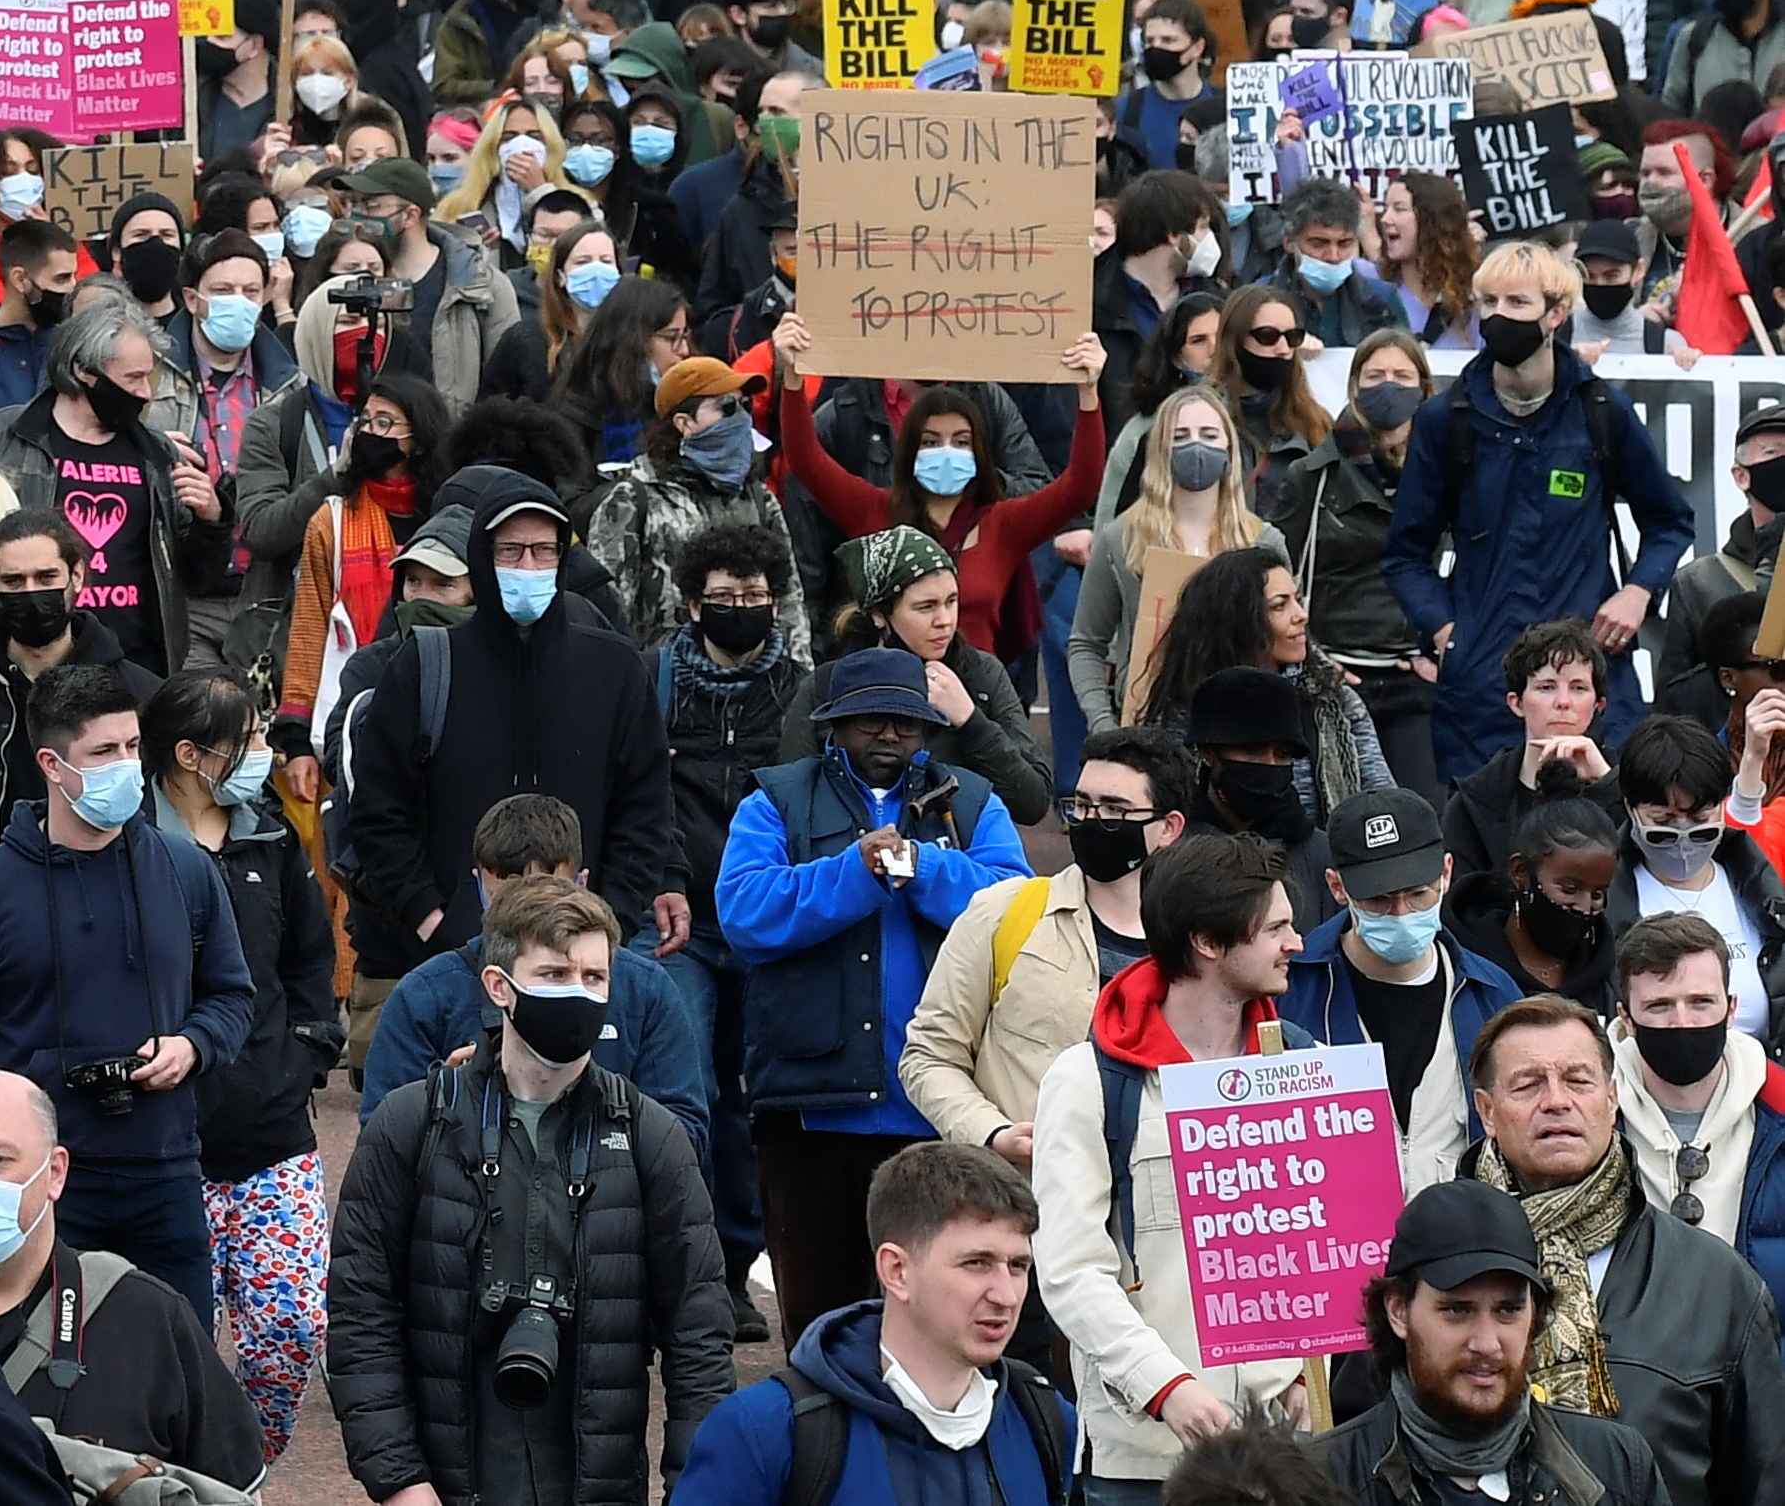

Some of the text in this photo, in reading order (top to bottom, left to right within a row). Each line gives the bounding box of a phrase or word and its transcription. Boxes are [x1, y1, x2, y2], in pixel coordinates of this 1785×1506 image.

[72, 0, 171, 27] Defend the
[42, 39, 64, 57] to
[73, 25, 145, 51] right to
[838, 18, 907, 48] THE
[1025, 26, 1106, 56] BILL
[74, 47, 143, 75] protest
[841, 49, 920, 79] BILL
[75, 68, 177, 94] Black Lives
[1370, 61, 1470, 103] REVOLUTION
[76, 96, 140, 117] Matter
[814, 111, 1091, 171] RIGHTS IN THE
[1473, 120, 1550, 163] KILL
[50, 146, 180, 190] KILL
[1482, 157, 1548, 196] THE
[914, 173, 991, 211] UK:
[1486, 187, 1567, 233] BILL
[804, 222, 1047, 273] THE RIGHT
[851, 286, 1068, 342] TO PROTEST
[91, 550, 109, 574] 4
[75, 585, 139, 608] AYOR
[1254, 1060, 1325, 1083] STAND UP
[1256, 1075, 1334, 1098] TO RACISM
[1178, 1100, 1376, 1153] Defend the
[1186, 1154, 1326, 1201] right to
[1192, 1195, 1328, 1248] protest
[1198, 1237, 1392, 1283] Black Lives
[59, 1287, 76, 1343] Canon
[1203, 1288, 1330, 1331] Matter
